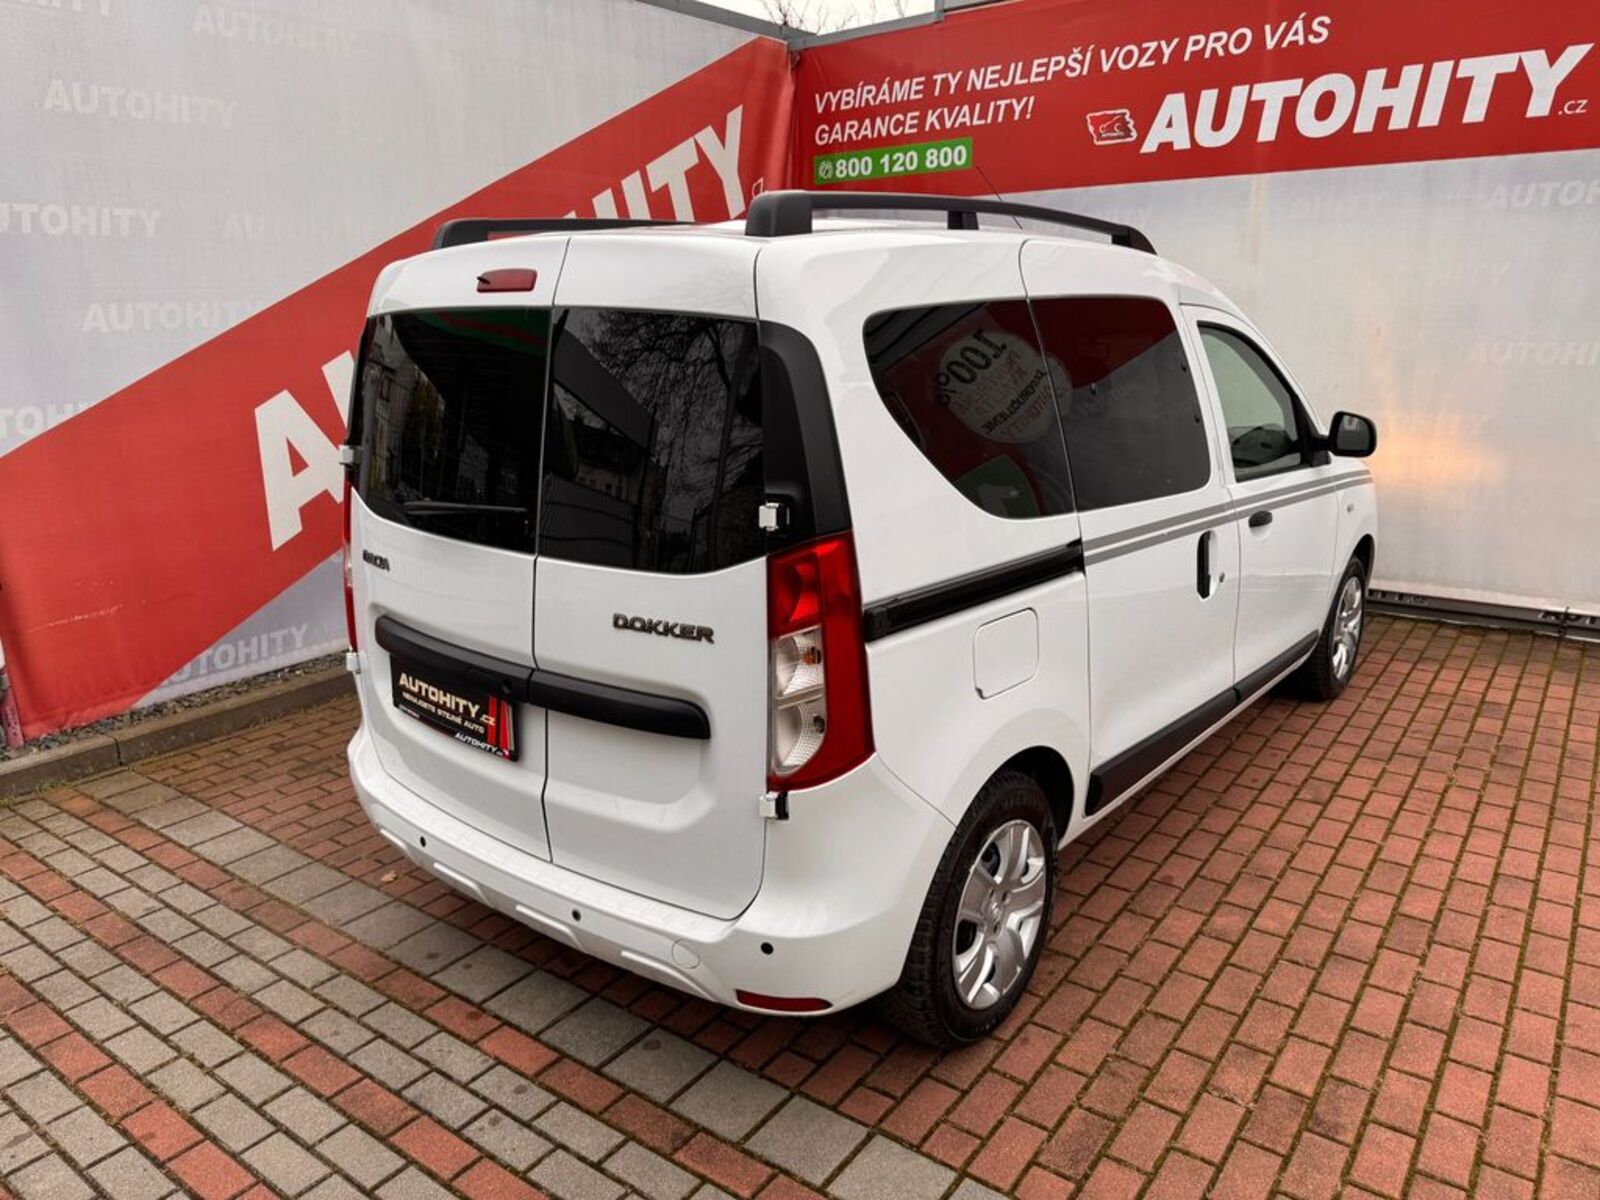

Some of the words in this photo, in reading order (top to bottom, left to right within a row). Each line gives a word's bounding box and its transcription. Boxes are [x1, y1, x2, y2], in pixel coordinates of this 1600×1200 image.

[814, 76, 924, 114] VYBÍRÁME
[933, 71, 962, 97] TY
[966, 45, 1094, 91] NEJLEPŠÍ
[1100, 37, 1179, 73] VOZY
[1184, 27, 1252, 62] PRO
[1264, 12, 1332, 51] VÁS
[44, 78, 238, 128] AUTOHITY
[814, 112, 918, 146] GARANCE
[925, 96, 1035, 133] KVALITY!
[835, 156, 872, 179] 800
[880, 150, 918, 173] 120
[925, 145, 967, 169] 800
[612, 613, 715, 644] DOKKER
